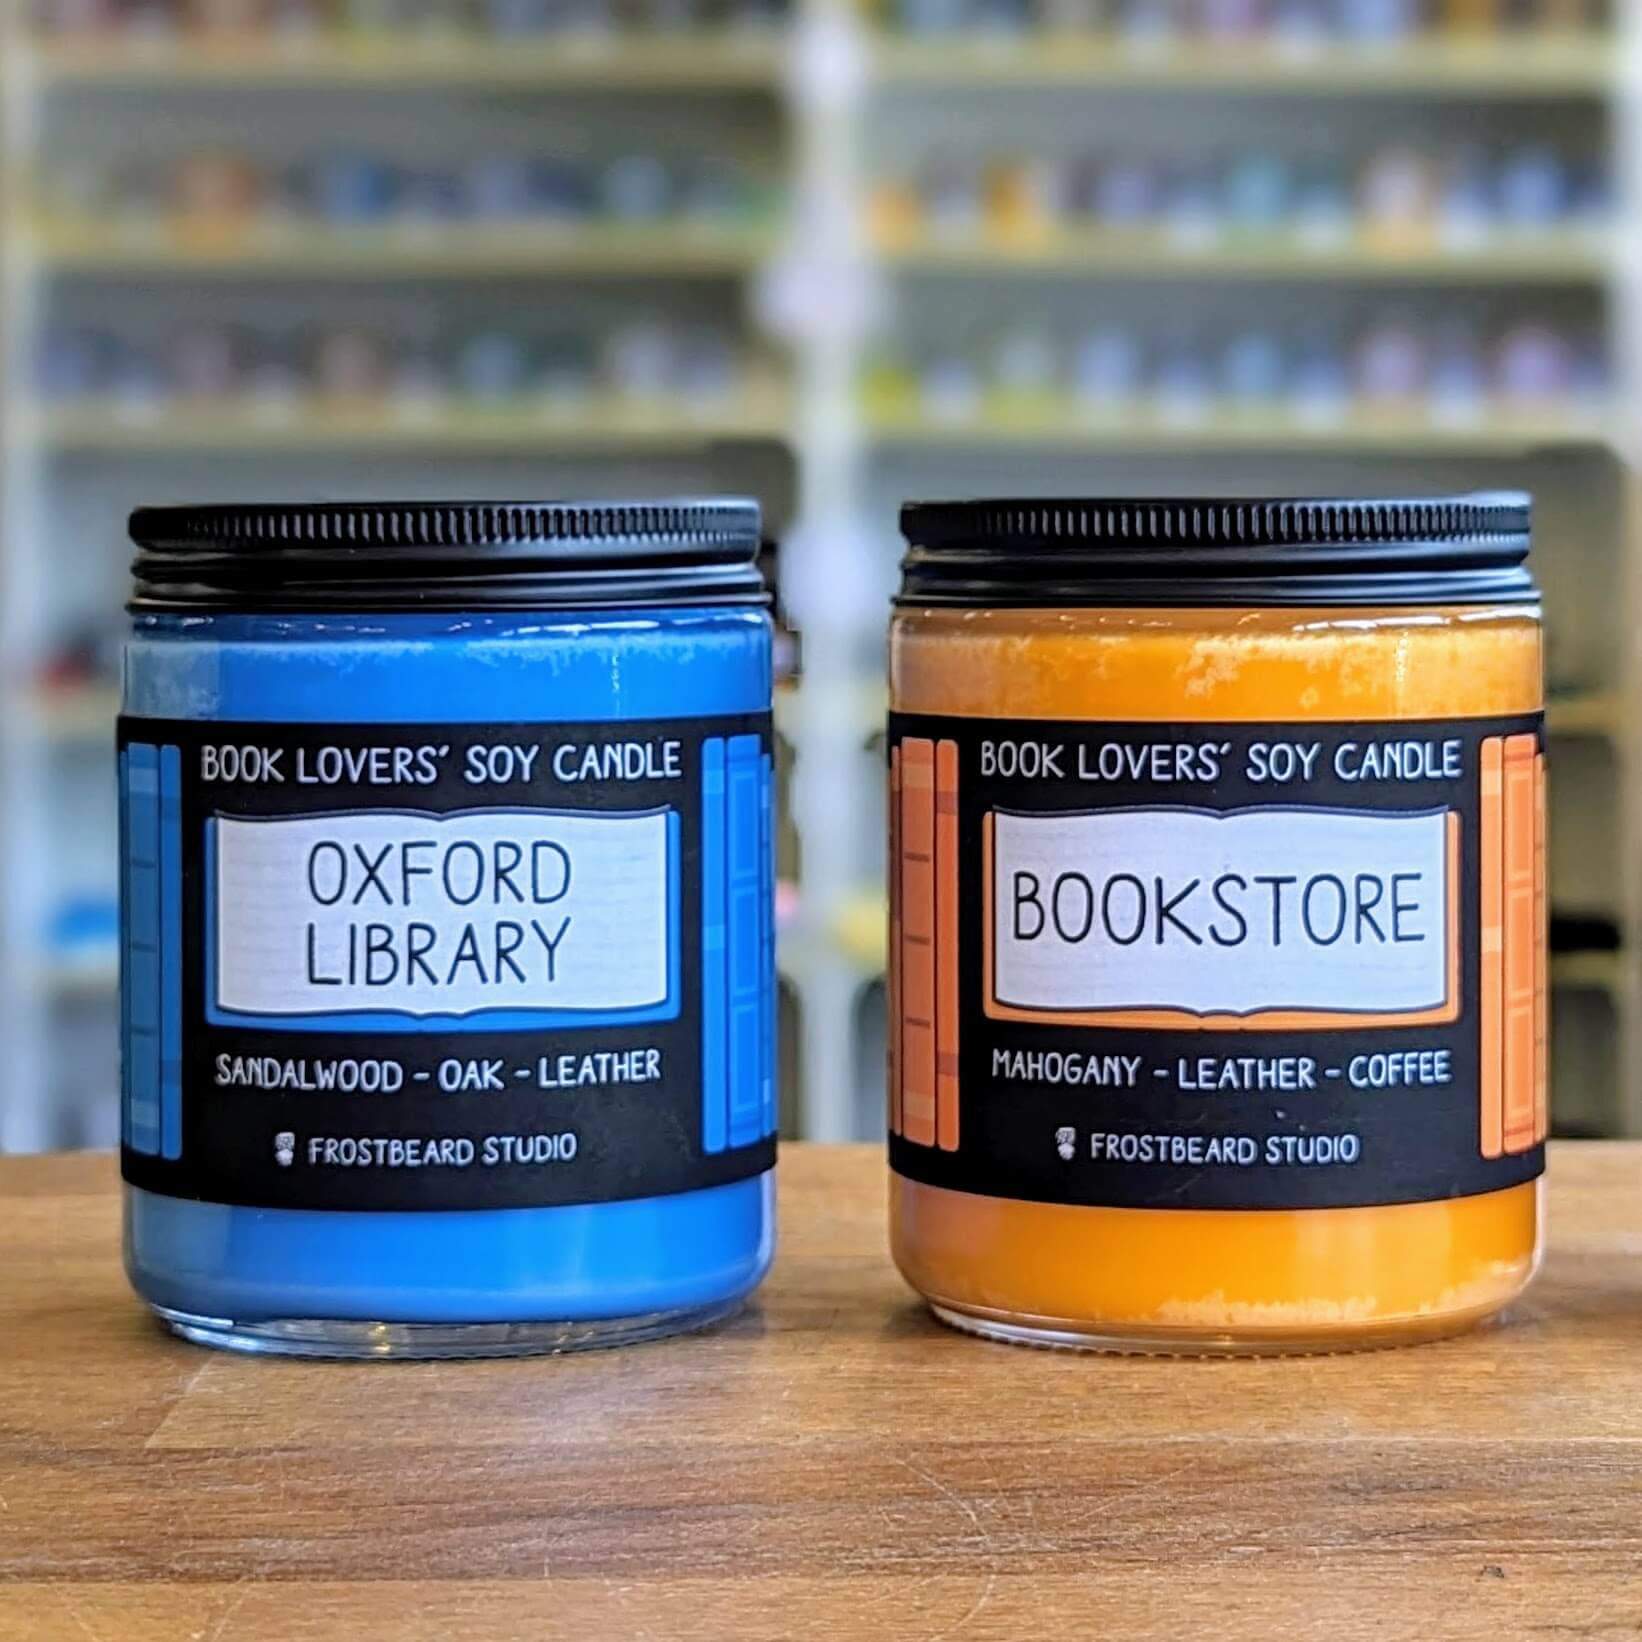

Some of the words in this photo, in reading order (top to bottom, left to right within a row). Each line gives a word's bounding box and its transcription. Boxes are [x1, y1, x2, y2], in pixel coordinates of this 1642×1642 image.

[203, 744, 285, 782] BOOK
[464, 744, 540, 783] SOY
[553, 741, 682, 782] CANDLE
[981, 740, 1065, 778] BOOK
[1246, 742, 1321, 781] SOY
[1334, 739, 1462, 781] CANDLE
[307, 840, 571, 907] OXFORD
[1013, 870, 1425, 947] BOOKSTORE
[307, 916, 571, 987] LIBRARY
[217, 1053, 403, 1092] SANDALWOOD
[438, 1059, 505, 1091] OAK
[539, 1048, 661, 1088] LEATHER
[992, 1048, 1141, 1086] MAHOGANY
[1178, 1057, 1316, 1090] LEATHER
[1348, 1049, 1452, 1088] COFFEE
[309, 1137, 474, 1166] FROSTBEARD
[482, 1132, 577, 1164] STUDIO
[1091, 1133, 1256, 1164] FROSTBEARD
[1265, 1134, 1359, 1164] STUDIO
